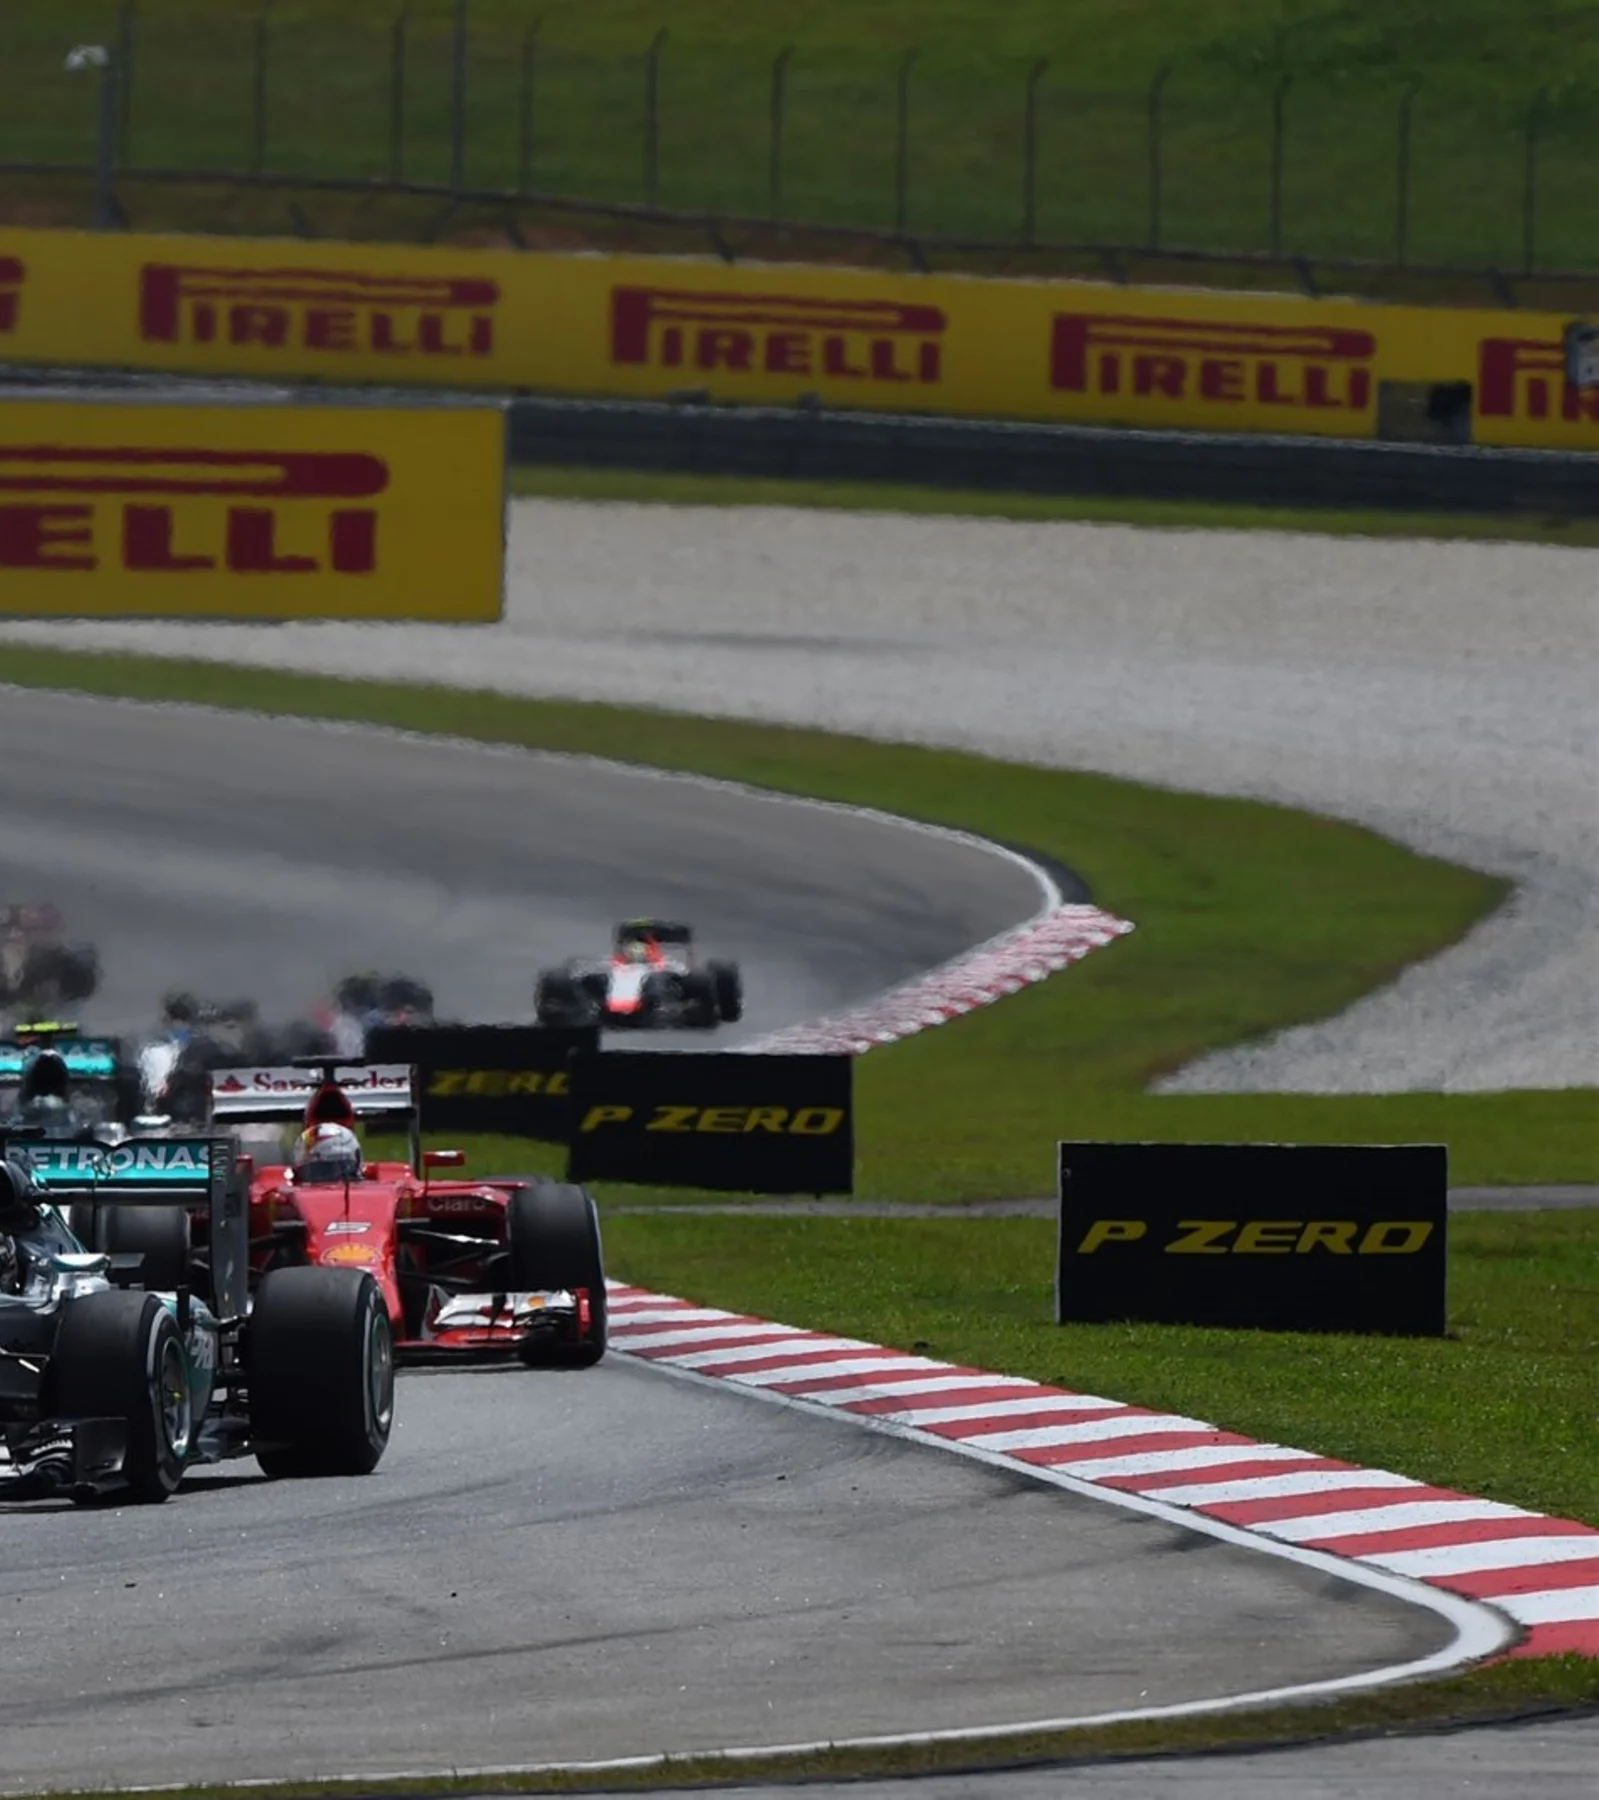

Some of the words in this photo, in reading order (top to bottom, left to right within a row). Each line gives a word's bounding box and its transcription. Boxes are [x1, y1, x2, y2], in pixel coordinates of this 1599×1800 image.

[138, 263, 500, 357] PIRELLI
[610, 286, 947, 384] PIRELLI
[1049, 312, 1376, 410] PIRELLI
[580, 1106, 632, 1133] P
[645, 1106, 844, 1134] ZERO
[1078, 1219, 1148, 1254] P
[1164, 1220, 1434, 1255] ZERO
